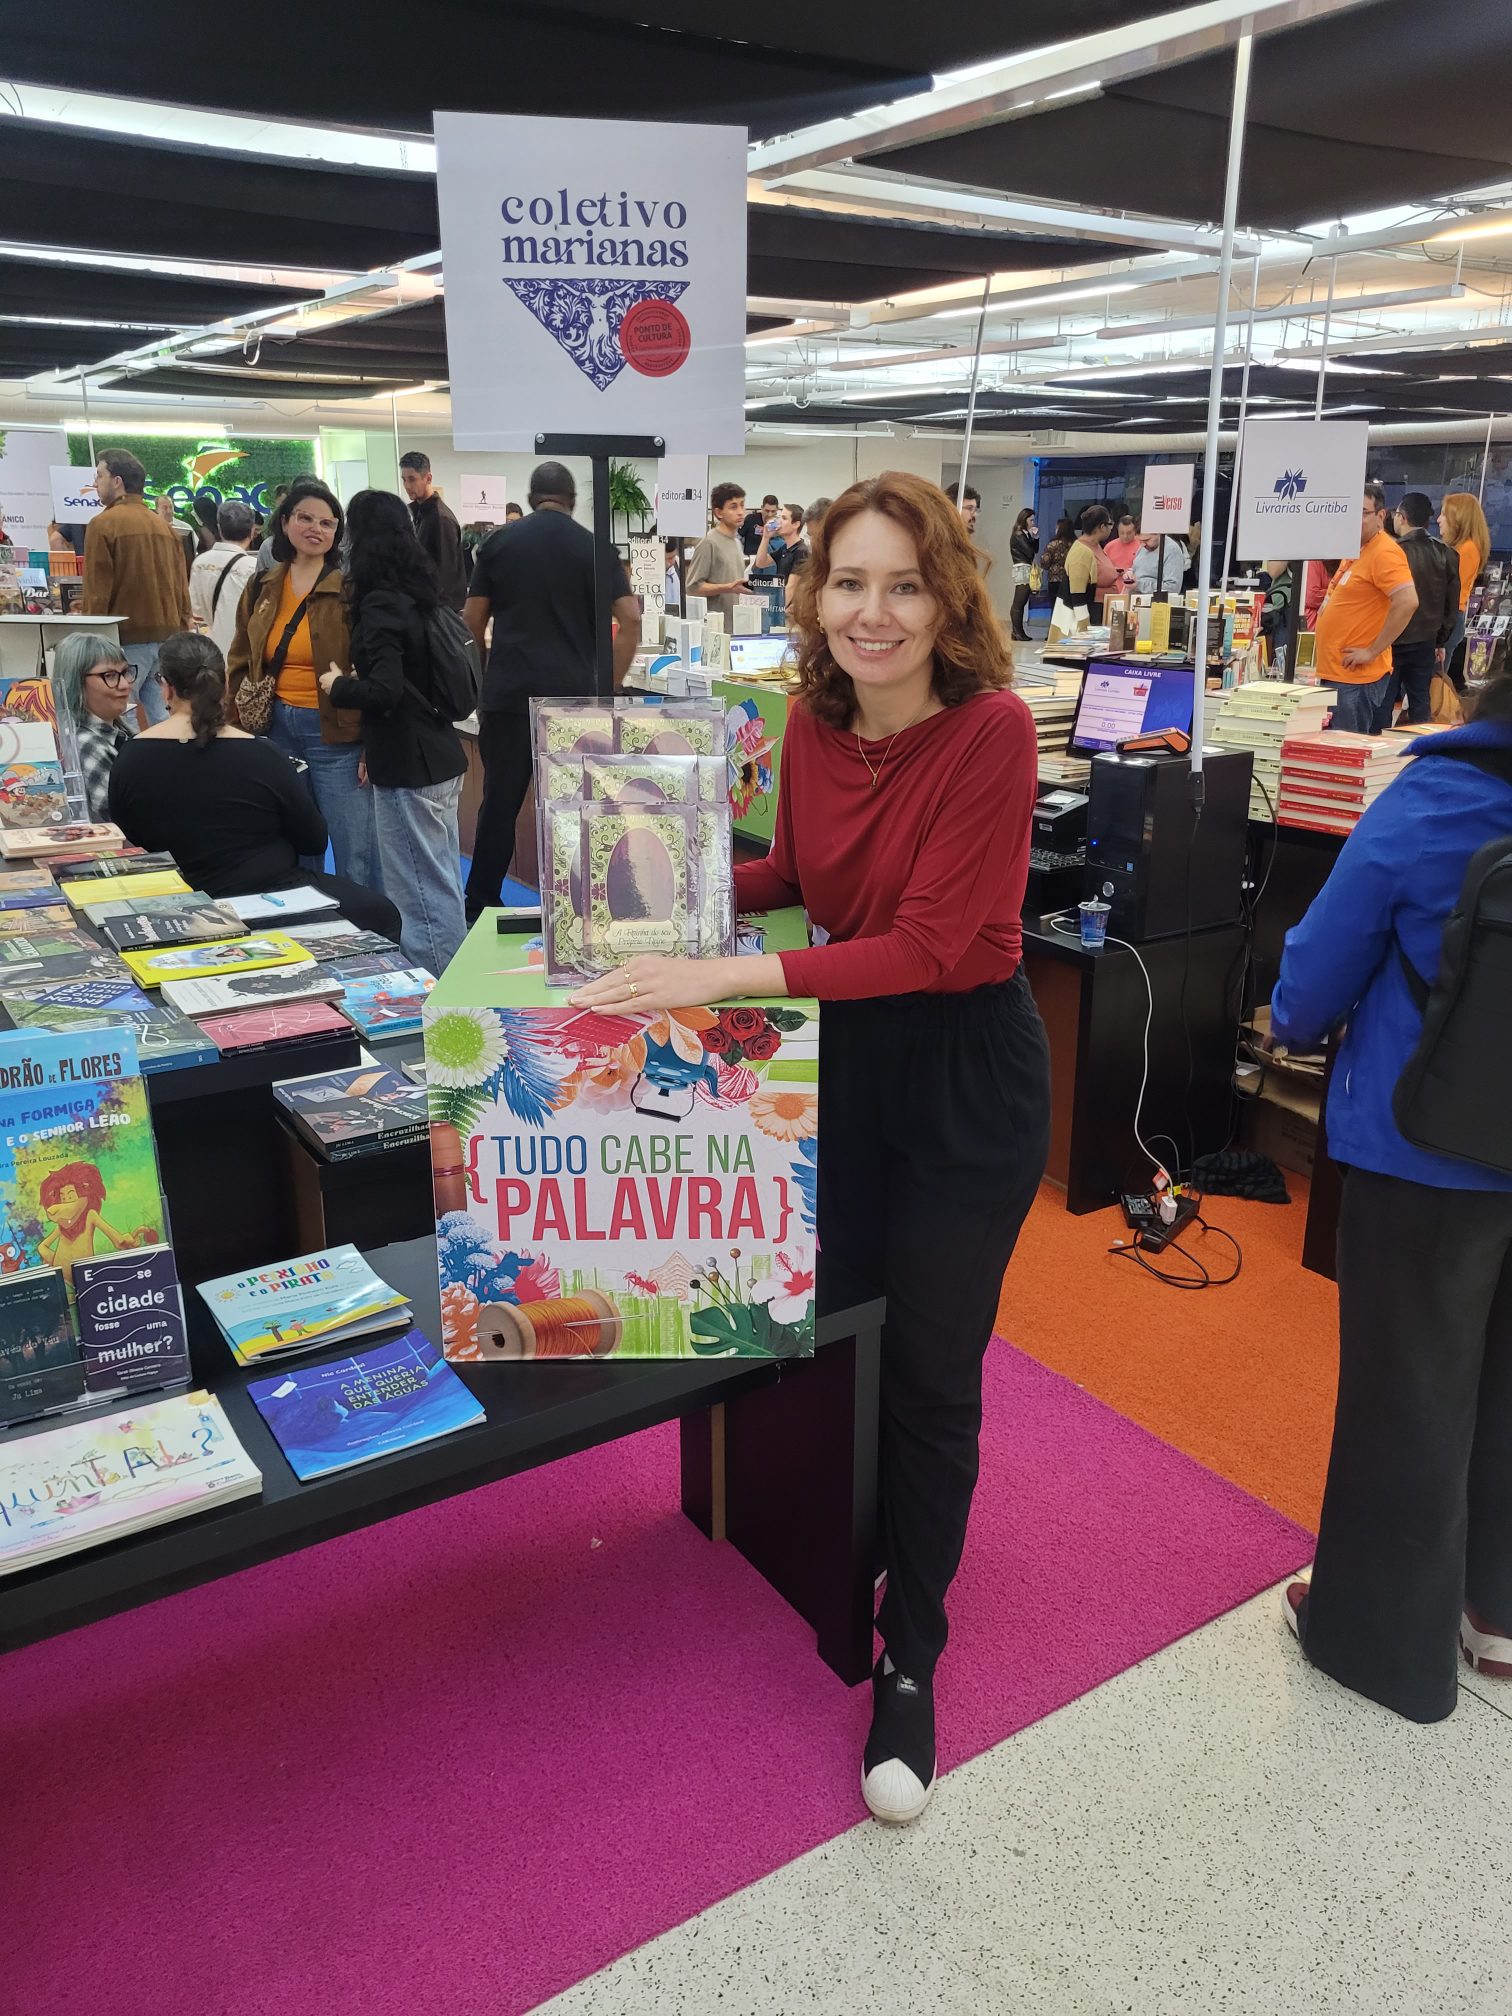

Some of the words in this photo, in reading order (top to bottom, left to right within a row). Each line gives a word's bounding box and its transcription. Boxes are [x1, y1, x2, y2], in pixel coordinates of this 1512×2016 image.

[501, 188, 687, 229] coletivo
[501, 229, 689, 268] marianas
[634, 324, 660, 335] PONTO
[661, 323, 673, 331] DE
[638, 332, 673, 343] CULTURA
[661, 489, 686, 500] editora
[693, 489, 702, 501] 34
[1255, 501, 1300, 514] Livrarias
[1305, 501, 1348, 514] Curitiba
[48, 1074, 57, 1084] DE
[59, 1052, 122, 1082] FLORES
[21, 1099, 95, 1125] FORMIGA
[6, 1136, 15, 1147] E
[18, 1134, 28, 1144] O
[32, 1121, 84, 1141] SENHOR
[89, 1109, 131, 1129] LEÃO
[10, 1158, 37, 1167] Pereira
[38, 1153, 69, 1162] Louzada
[600, 1134, 694, 1175] CABE
[707, 1134, 756, 1174] NA
[84, 1269, 94, 1281] E
[136, 1269, 152, 1279] se
[97, 1289, 165, 1315] cidade
[94, 1321, 120, 1332] fosse
[146, 1320, 168, 1330] uma
[98, 1335, 174, 1364] mulher?
[344, 1385, 372, 1396] QUE
[375, 1365, 425, 1387] QUERIA
[354, 1365, 407, 1385] MENINA
[348, 1376, 417, 1403] ENTENDER
[352, 1397, 380, 1409] DAS
